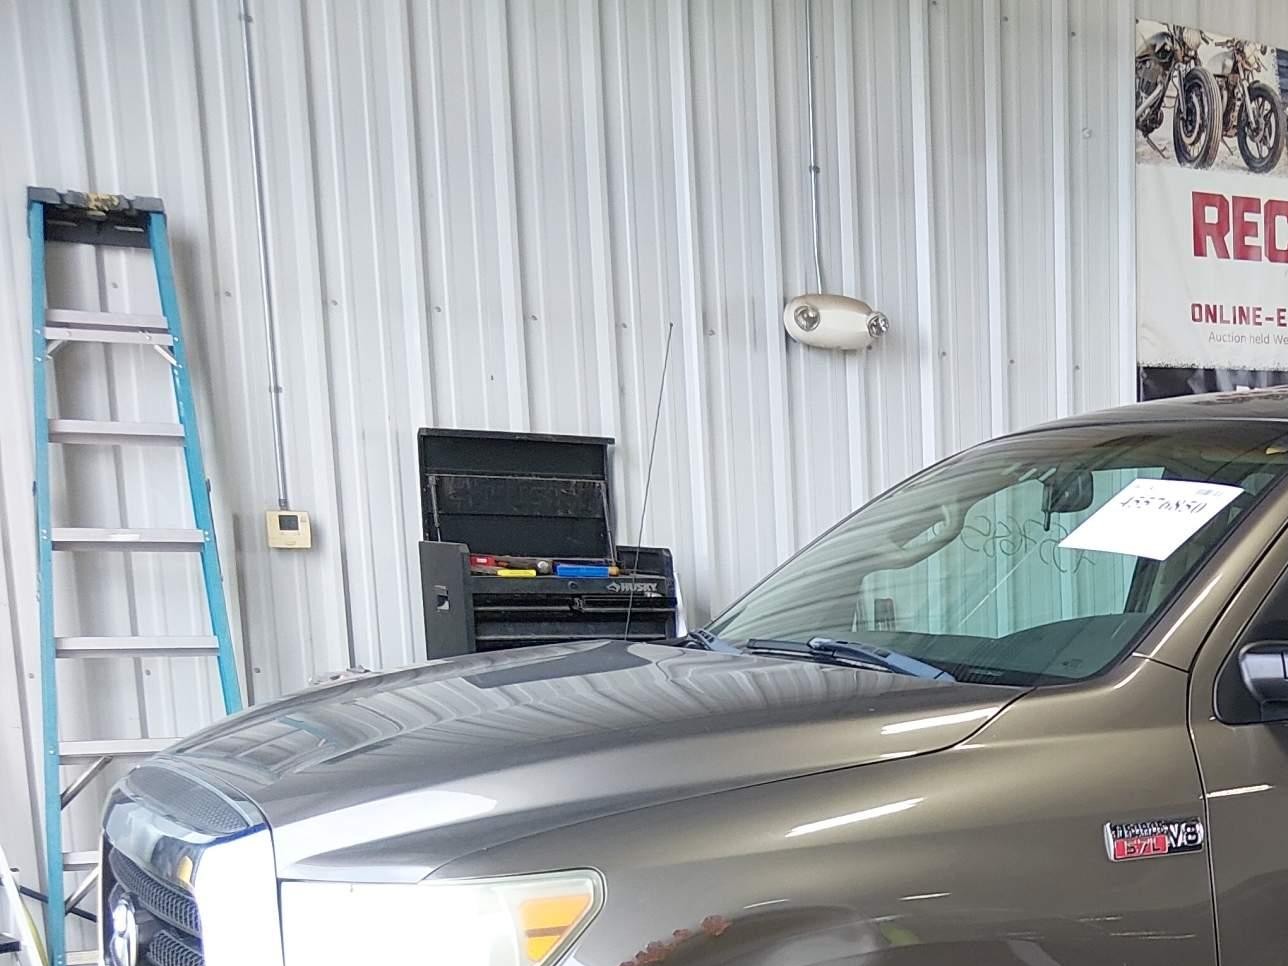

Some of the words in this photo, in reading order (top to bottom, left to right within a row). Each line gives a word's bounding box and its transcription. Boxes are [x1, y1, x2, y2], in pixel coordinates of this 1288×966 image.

[1208, 331, 1247, 345] Auction
[1249, 332, 1270, 345] held
[1169, 821, 1203, 848] V8
